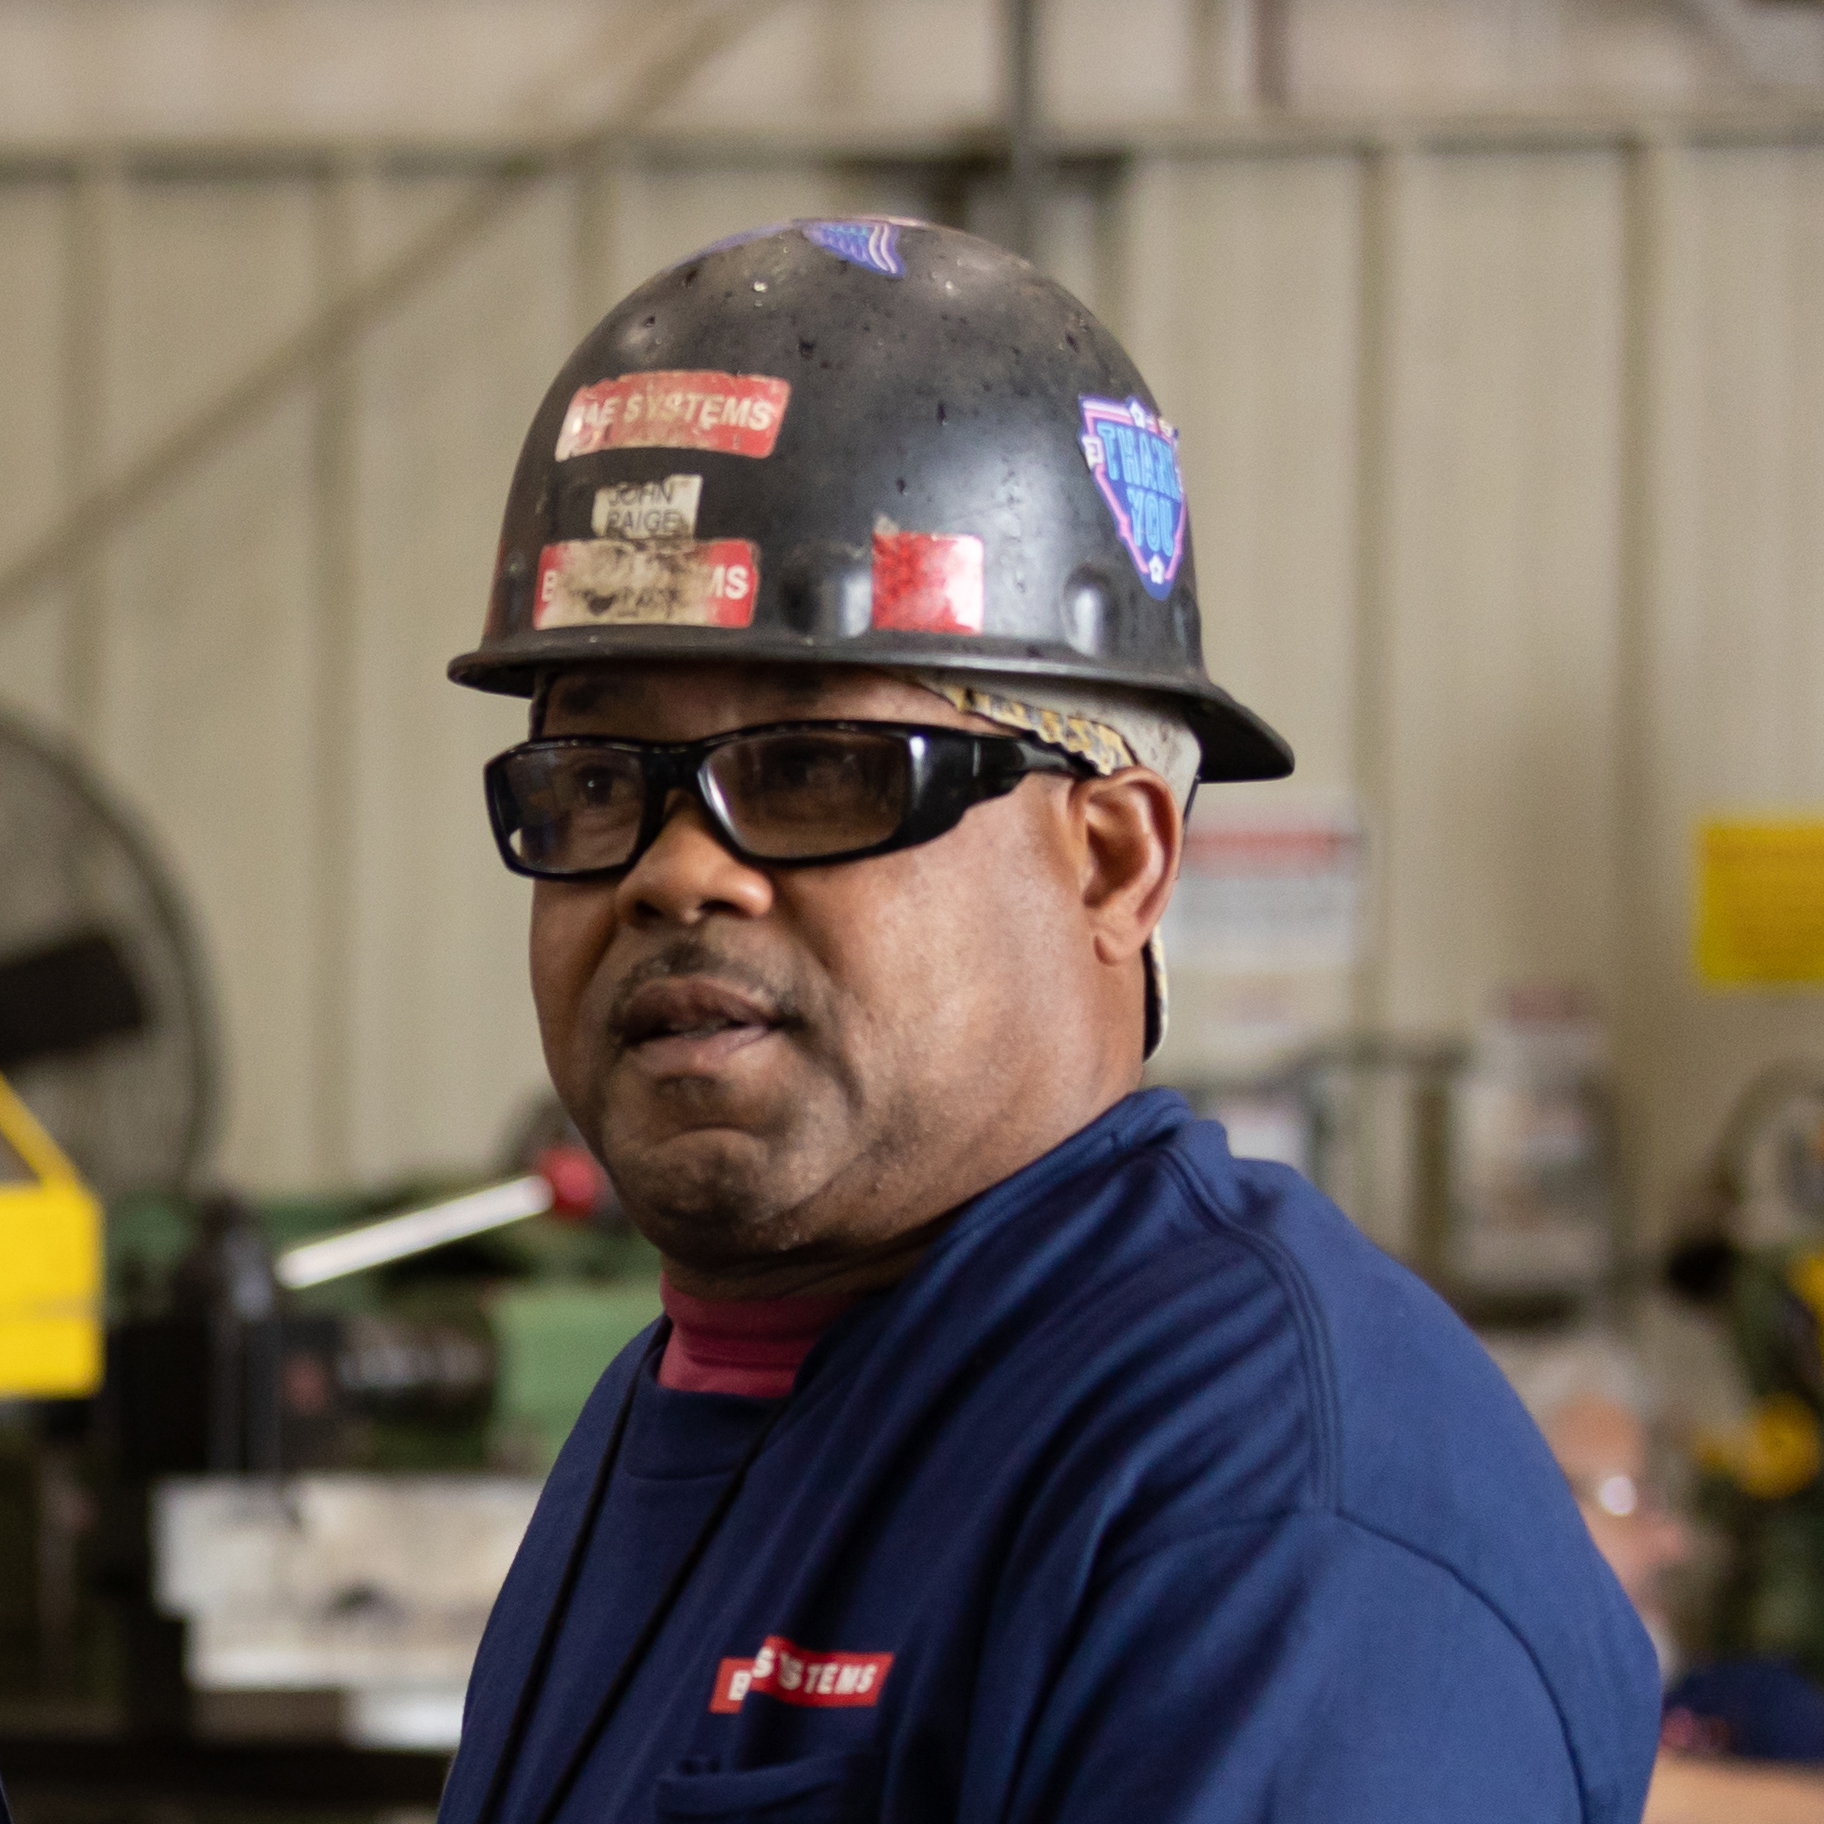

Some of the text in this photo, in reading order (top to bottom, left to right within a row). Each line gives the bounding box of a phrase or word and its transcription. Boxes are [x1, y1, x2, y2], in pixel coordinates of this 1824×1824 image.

[571, 391, 774, 431] AE SYSTEMS
[1126, 485, 1173, 557] YOU
